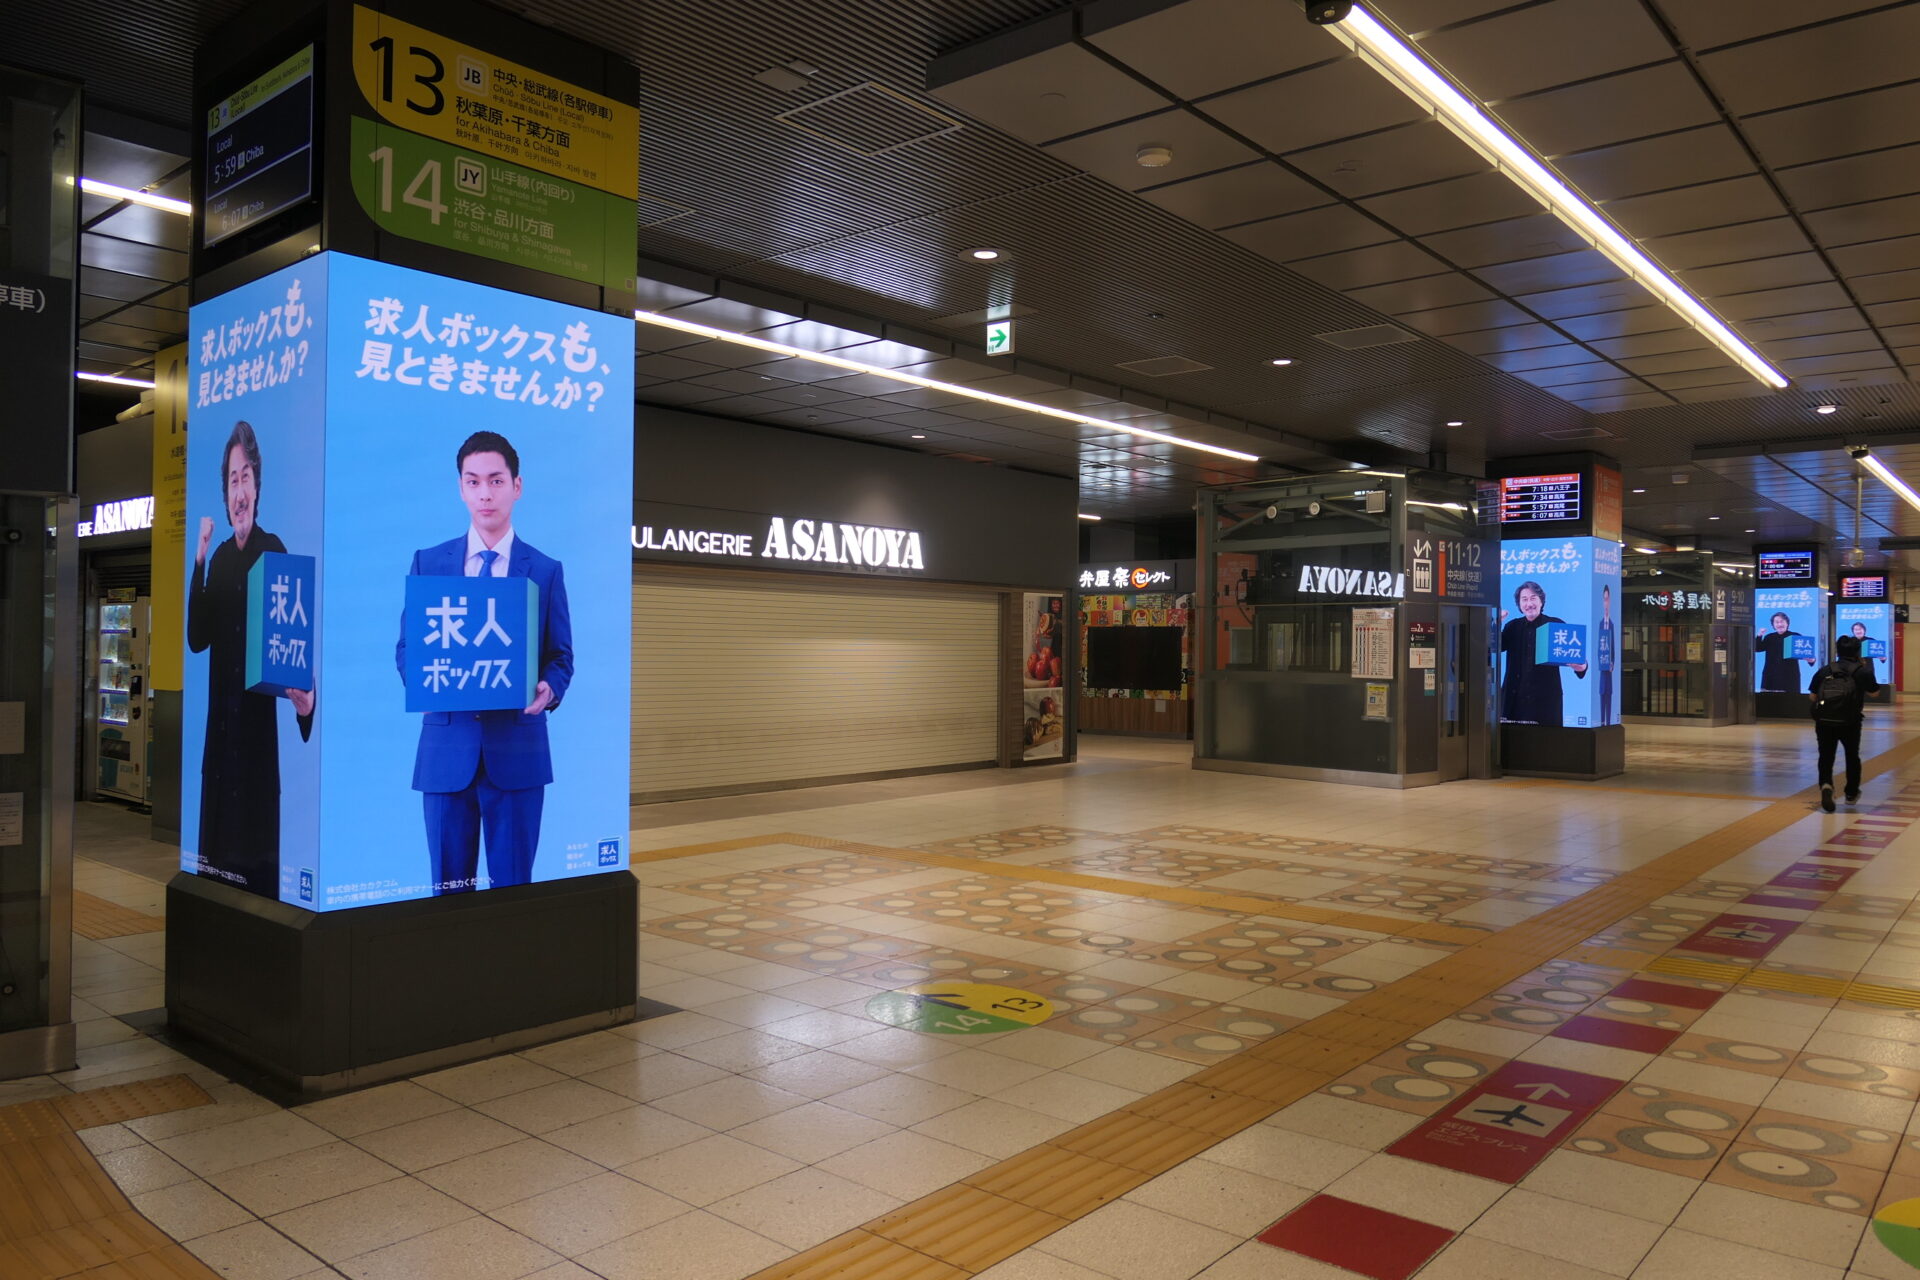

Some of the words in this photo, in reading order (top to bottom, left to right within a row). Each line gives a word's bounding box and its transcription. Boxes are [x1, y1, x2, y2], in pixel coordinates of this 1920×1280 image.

[369, 36, 445, 116] 13
[464, 67, 482, 85] JB
[210, 107, 220, 131] 13
[456, 96, 570, 149] 秋葉原・千葉方面
[217, 134, 233, 154] Local
[456, 116, 468, 127] for
[472, 119, 520, 146] Akihabara
[523, 139, 530, 148] &
[532, 141, 559, 157] Chiba
[215, 155, 237, 184] 5:59
[246, 144, 264, 163] Chiba
[462, 168, 480, 185] JY
[368, 146, 448, 225] 14
[214, 198, 228, 215] Local
[222, 208, 241, 232] 6:07
[249, 199, 264, 215] Chiba
[454, 198, 554, 240] 渋谷・品川方面
[454, 217, 468, 229] for
[470, 220, 509, 240] Shibuya
[521, 233, 571, 257] Shinagawa
[355, 339, 605, 413] 見ときませんか?
[1532, 485, 1549, 493] 7:18
[1532, 494, 1549, 502] 7:34
[1532, 503, 1549, 511] 5:57
[632, 526, 753, 557] ULANGERIE
[762, 516, 925, 570] ASANOYA
[270, 575, 308, 627] 求人
[424, 596, 512, 649] 求人
[1553, 629, 1582, 646] 求人
[269, 633, 306, 669] ボックス
[1553, 646, 1582, 658] ボックス
[1794, 639, 1813, 649] 求人
[423, 658, 512, 693] ボックス
[992, 997, 1044, 1013] 13
[935, 1014, 992, 1032] 14
